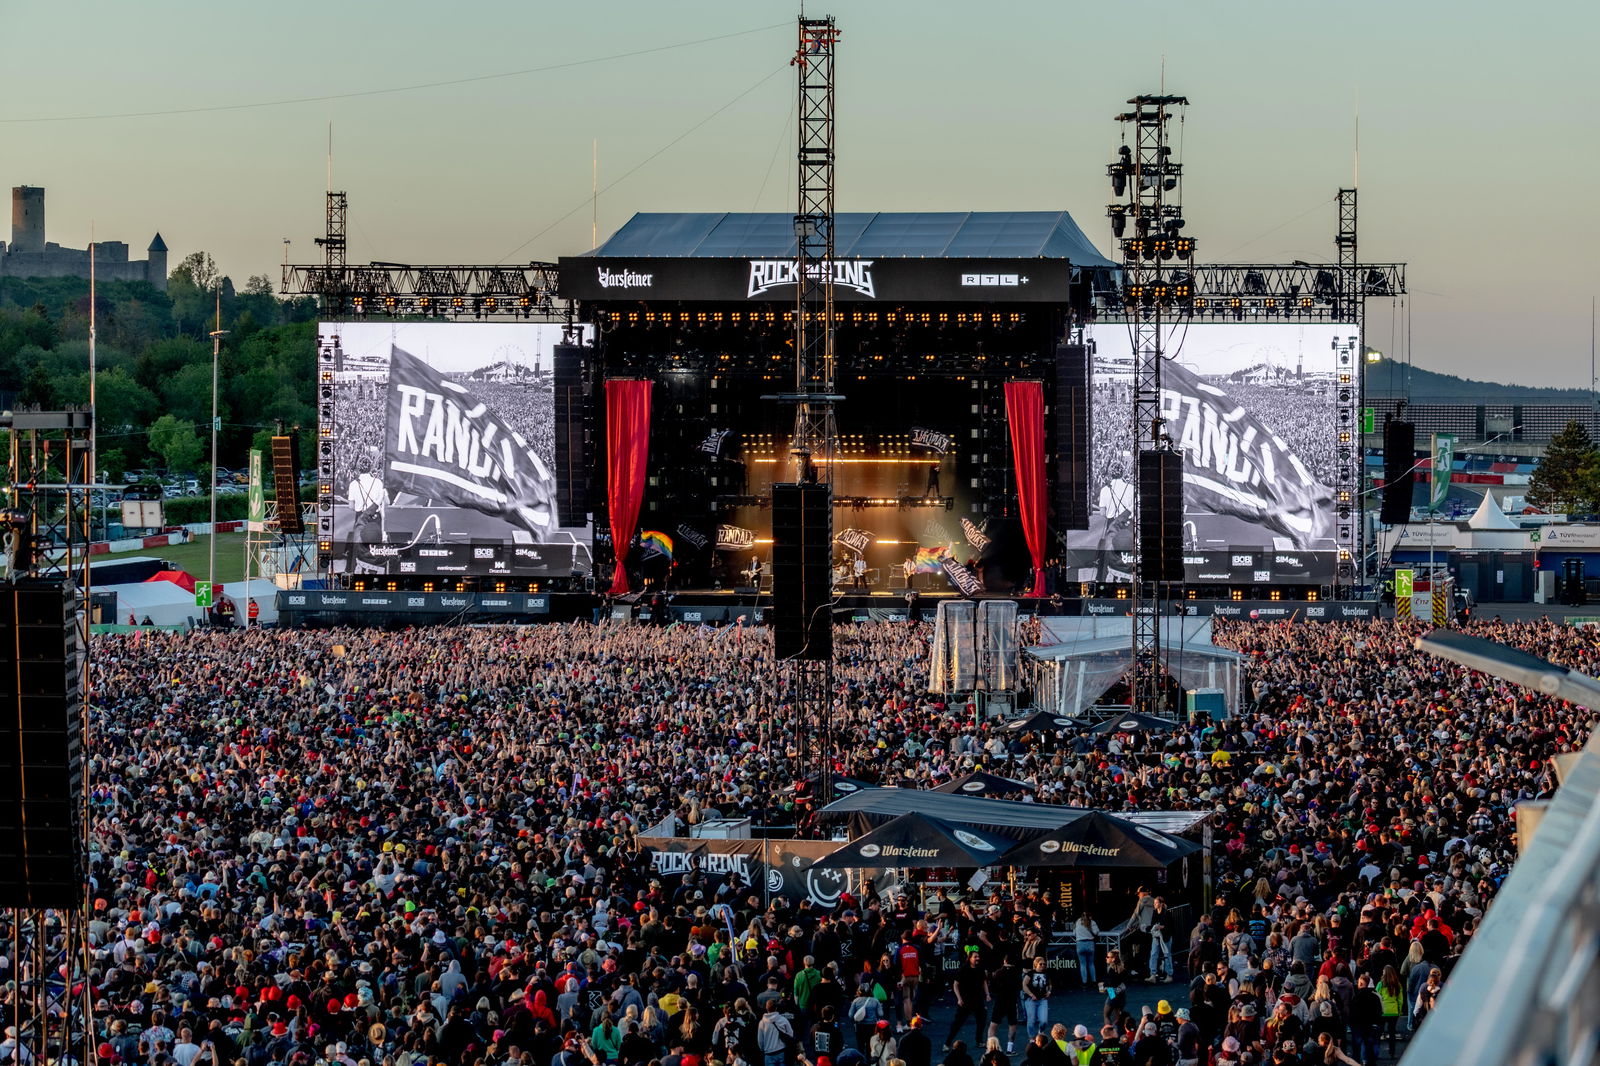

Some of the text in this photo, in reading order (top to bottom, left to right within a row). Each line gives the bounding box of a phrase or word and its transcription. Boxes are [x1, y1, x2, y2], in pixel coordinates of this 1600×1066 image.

[747, 261, 800, 298] ROCK
[882, 845, 939, 858] Warsteiner
[1061, 841, 1120, 857] Warsteiner
[651, 851, 693, 874] ROCK
[707, 853, 752, 887] RING
